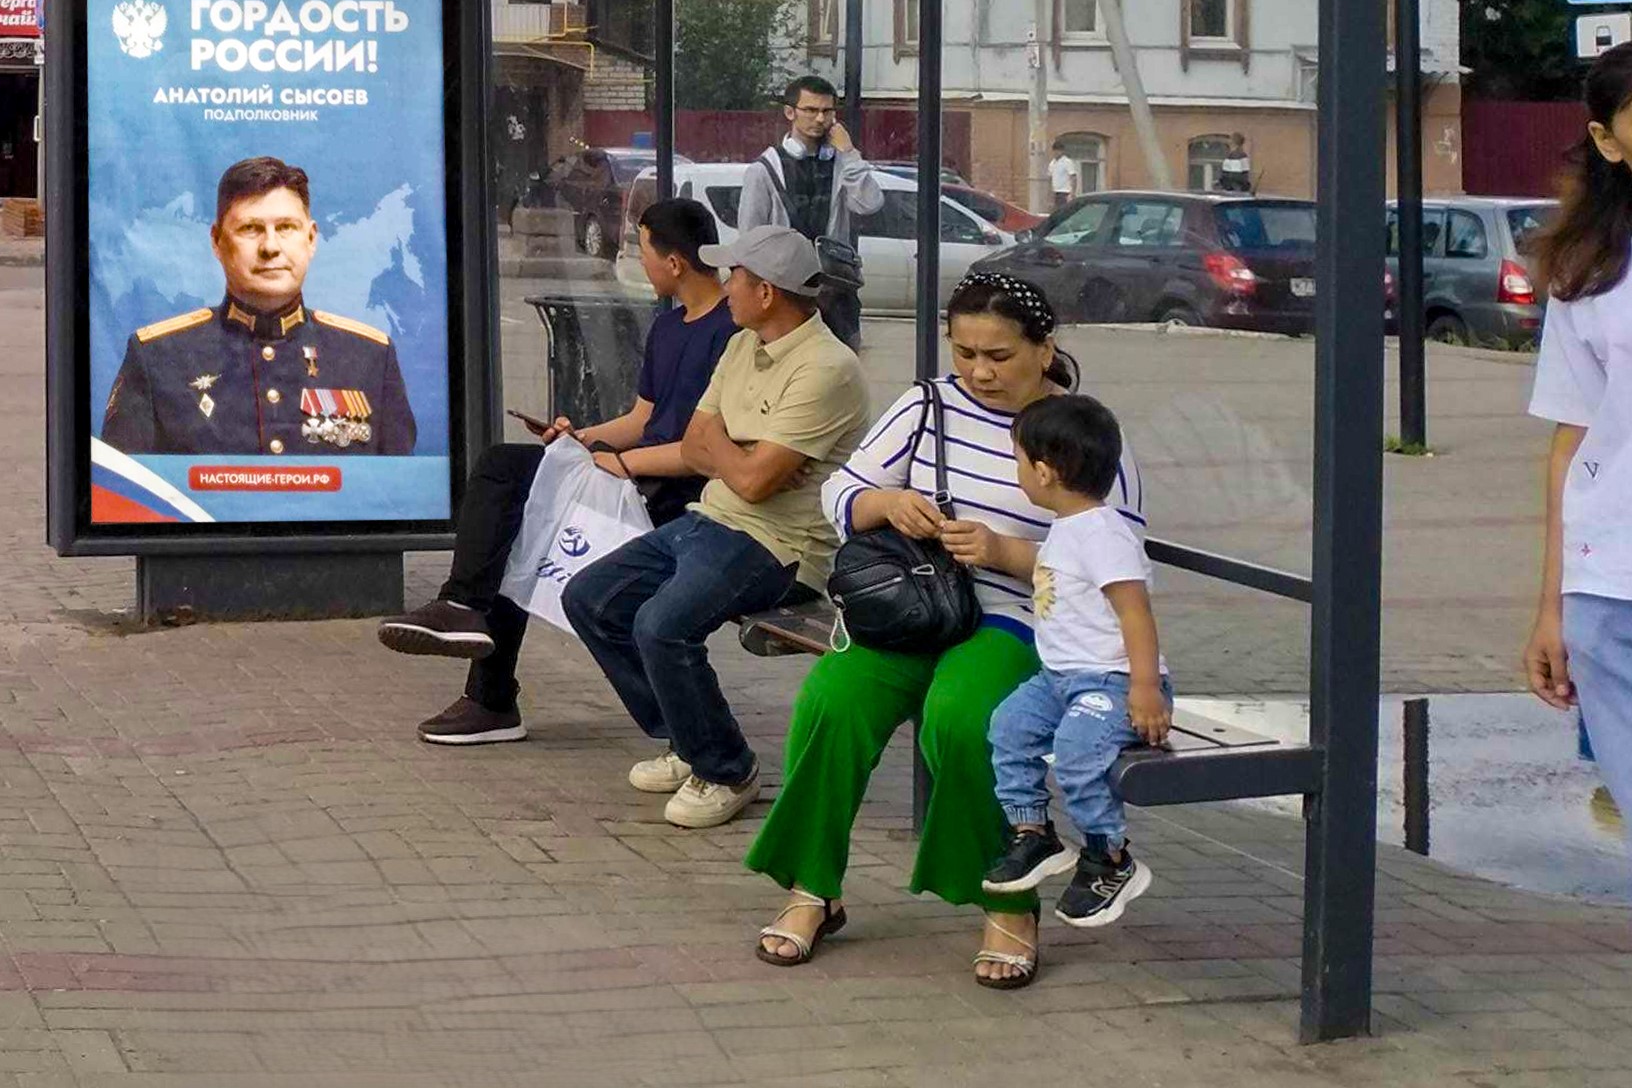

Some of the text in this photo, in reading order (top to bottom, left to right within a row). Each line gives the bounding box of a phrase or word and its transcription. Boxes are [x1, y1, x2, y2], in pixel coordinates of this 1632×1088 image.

[190, 38, 379, 73] РОССИИ!
[152, 84, 369, 105] АНАТОЛИЙ СЫСОЕВ
[204, 108, 319, 122] ПОДПОЛКОВНИК
[199, 472, 330, 485] НАСТОЯЩИЕ-ГЕРОИ.РФ
